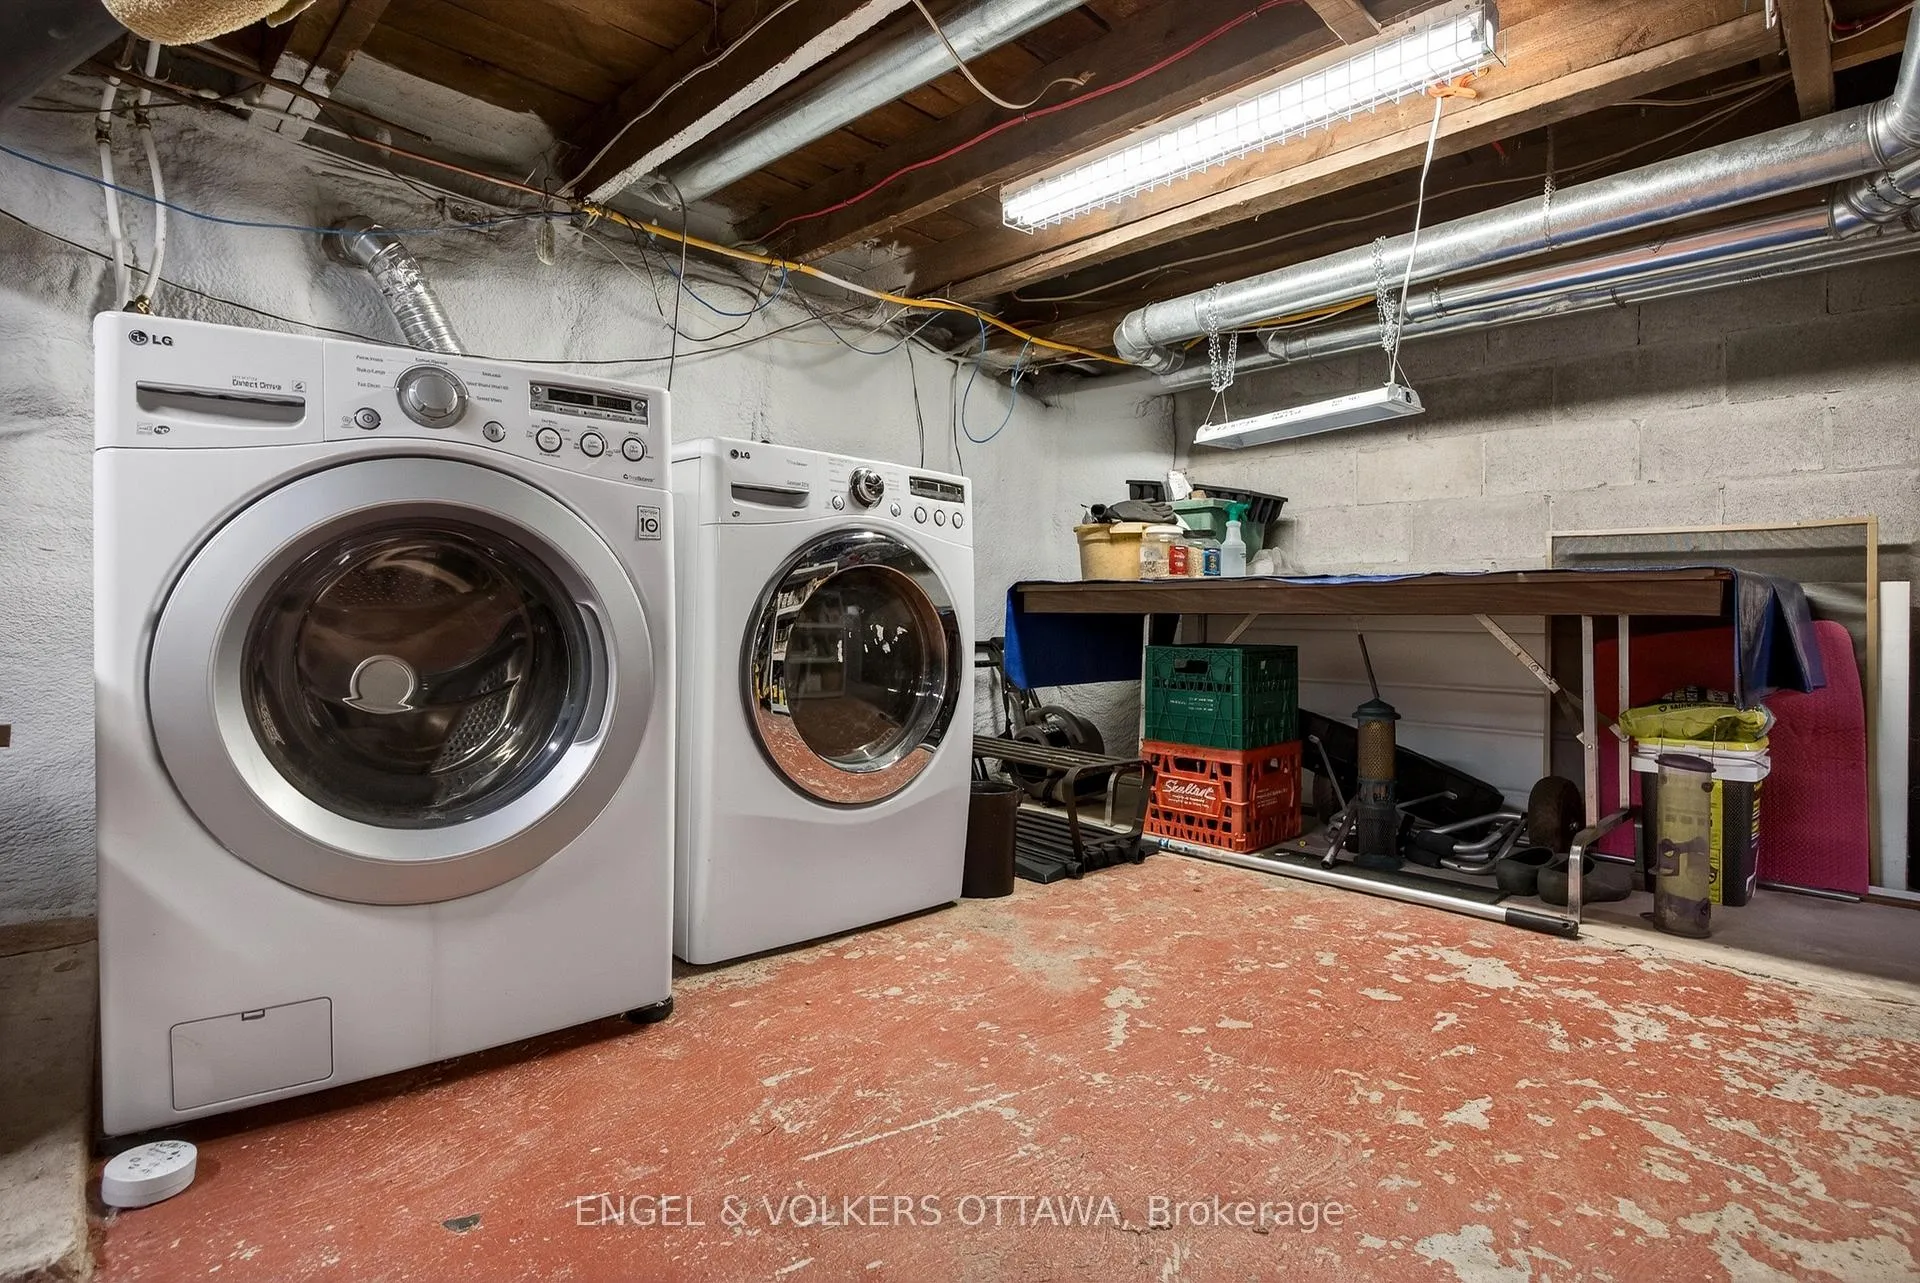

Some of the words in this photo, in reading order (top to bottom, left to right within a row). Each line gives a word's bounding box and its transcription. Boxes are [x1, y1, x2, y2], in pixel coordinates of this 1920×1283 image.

[152, 334, 173, 346] LG
[232, 379, 258, 389] Direct
[259, 381, 282, 391] Drive
[740, 451, 751, 460] LG
